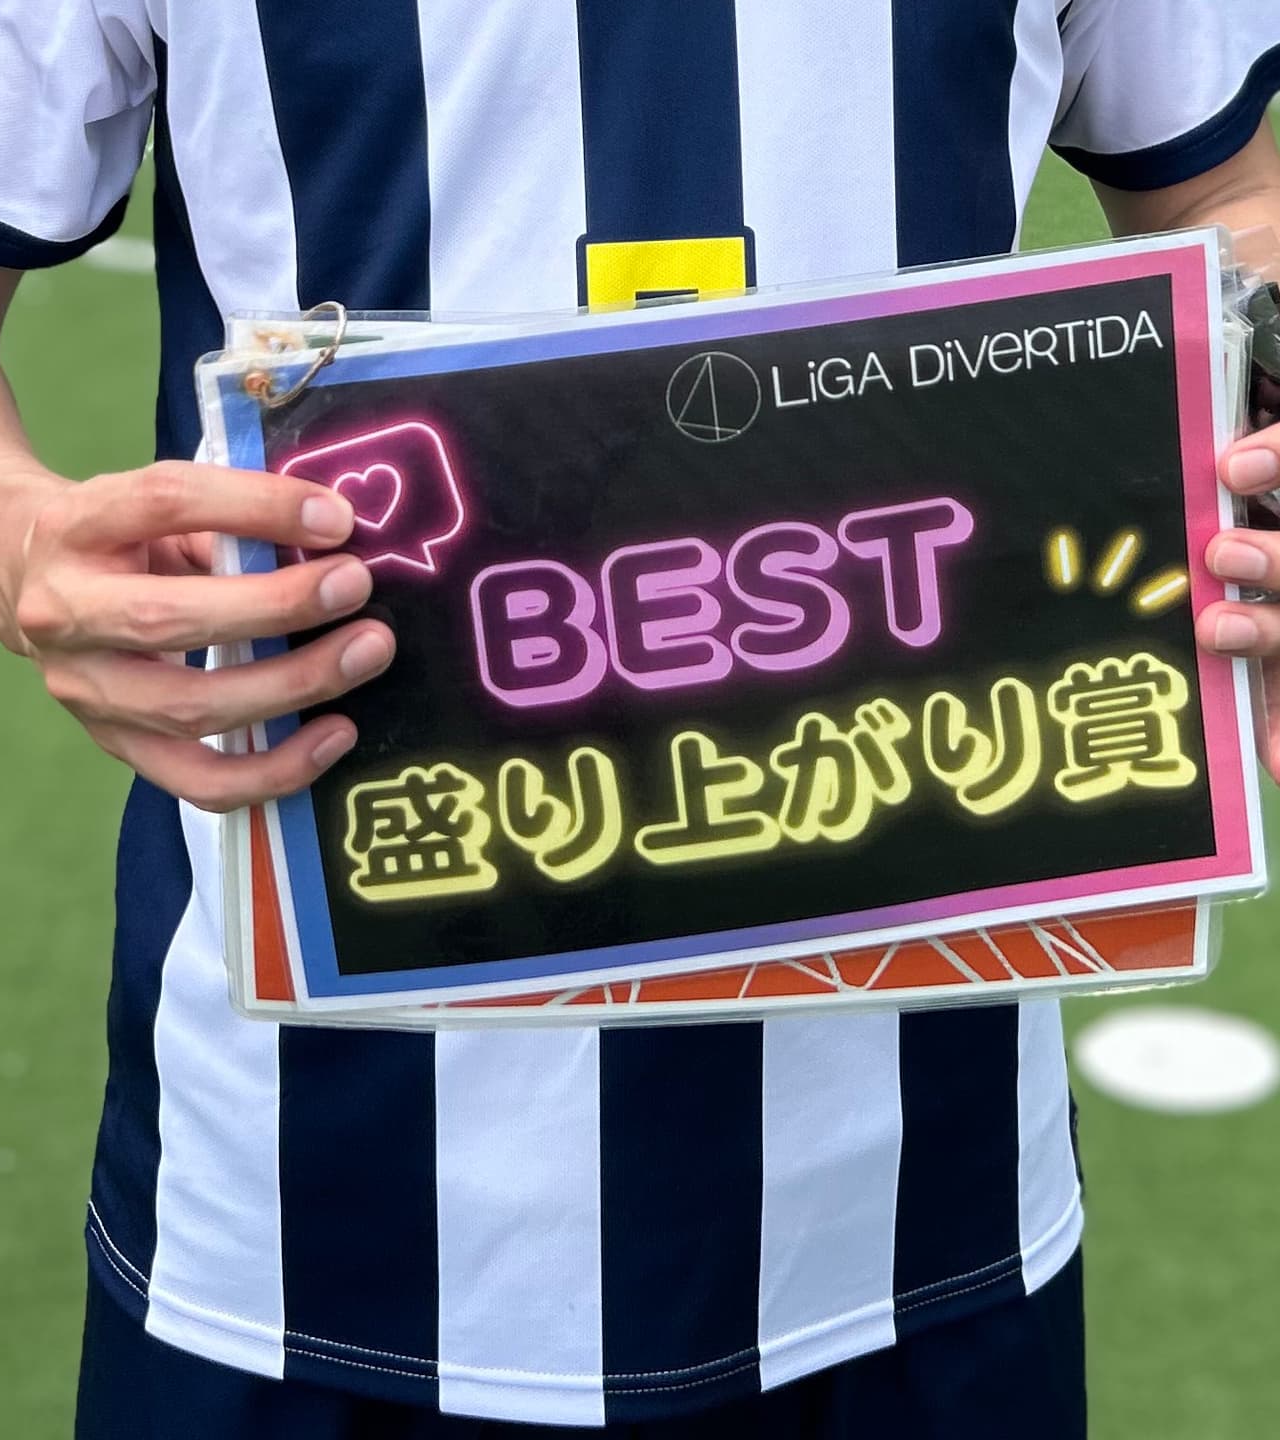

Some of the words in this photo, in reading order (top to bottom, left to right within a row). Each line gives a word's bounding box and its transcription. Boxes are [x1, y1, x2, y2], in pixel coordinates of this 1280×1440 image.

[470, 496, 975, 708] BEST
[346, 650, 1198, 904] 盛り上がり賞
